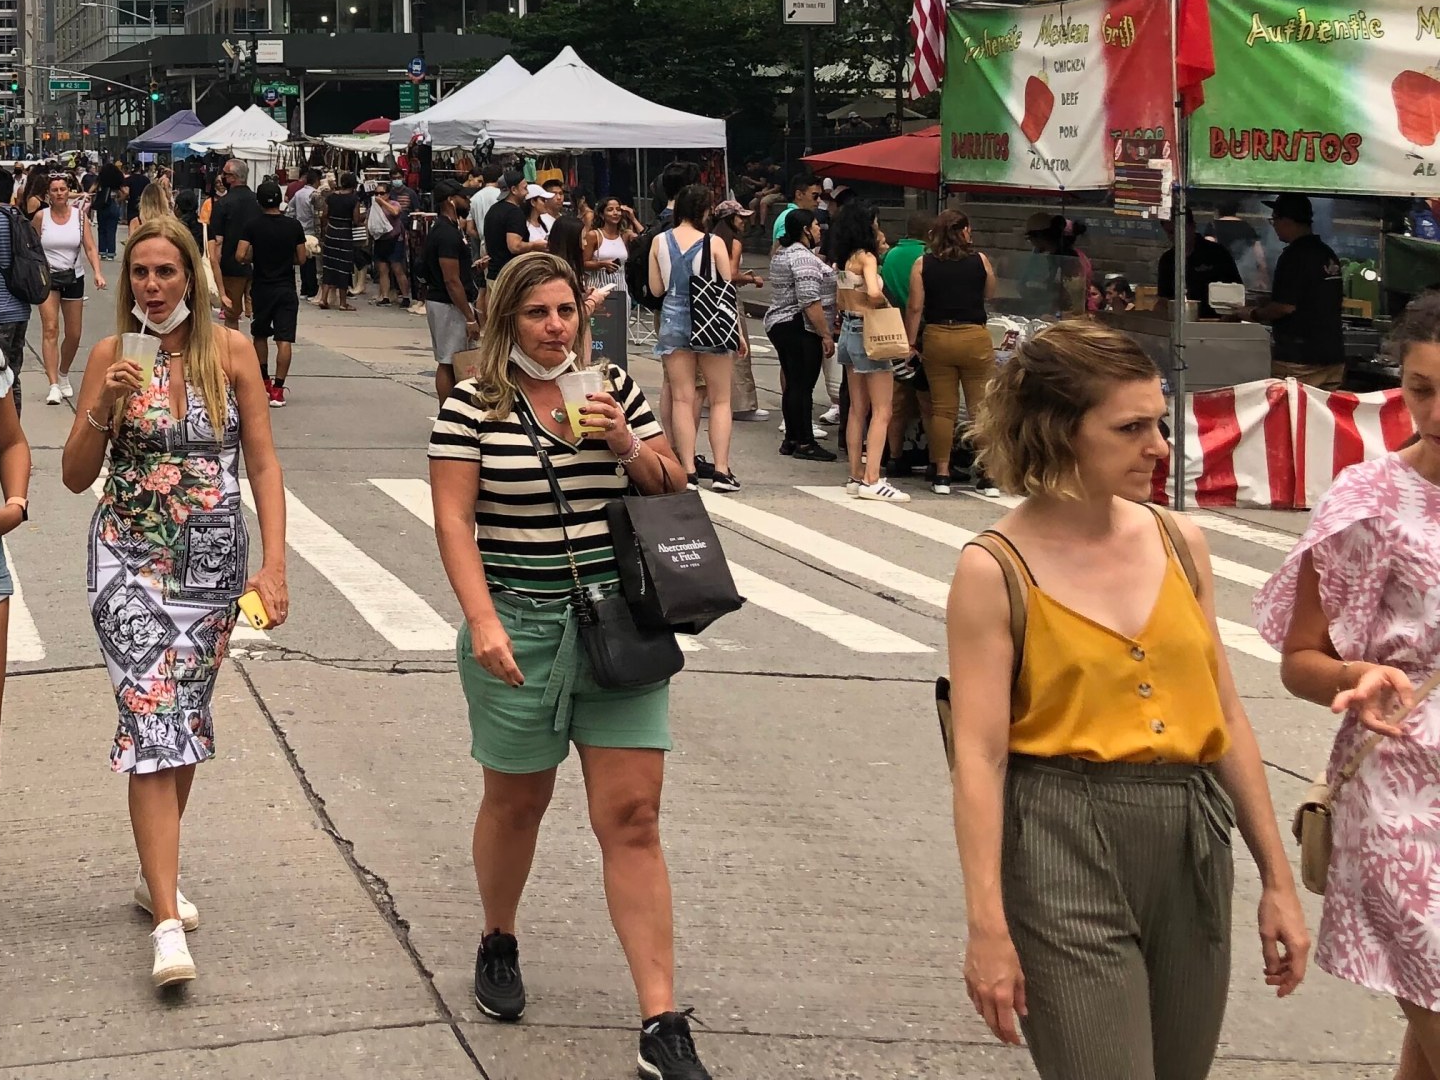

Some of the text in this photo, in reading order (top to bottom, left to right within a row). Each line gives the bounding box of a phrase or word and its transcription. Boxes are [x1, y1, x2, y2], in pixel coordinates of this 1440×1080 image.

[1245, 7, 1385, 48] Authentic
[1053, 57, 1086, 73] CHICKEN
[1061, 91, 1079, 106] BEEF
[1059, 125, 1079, 139] PORK
[951, 131, 1010, 162] BURRITOS
[1209, 126, 1363, 166] BURRITOS
[1412, 162, 1438, 177] AL
[869, 334, 895, 342] FOREVER
[657, 539, 707, 553] Abercrombie
[671, 550, 701, 563] & Fitch
